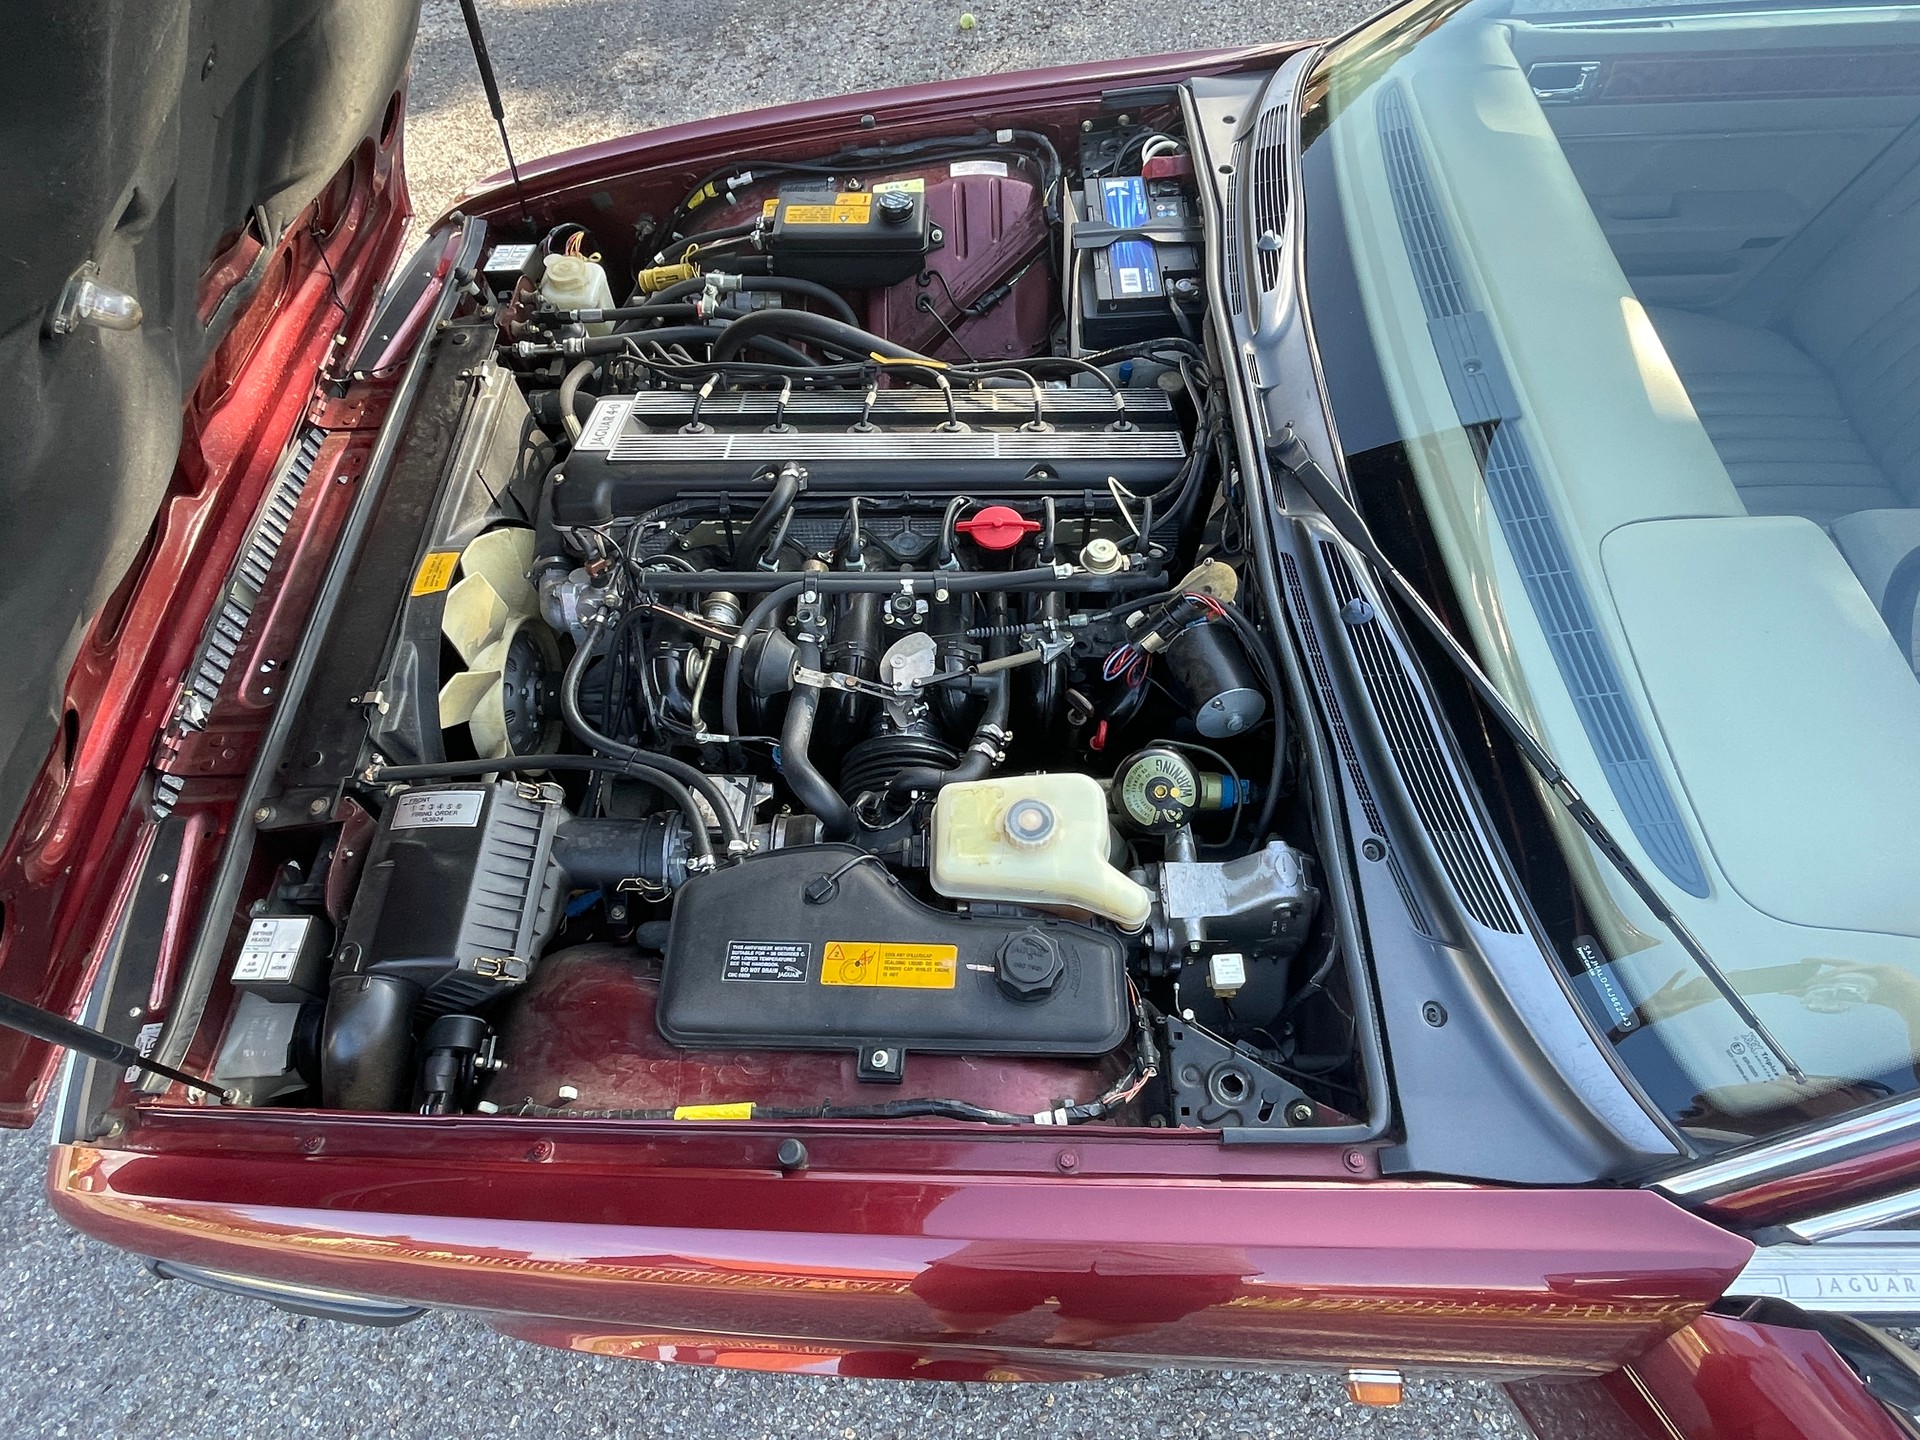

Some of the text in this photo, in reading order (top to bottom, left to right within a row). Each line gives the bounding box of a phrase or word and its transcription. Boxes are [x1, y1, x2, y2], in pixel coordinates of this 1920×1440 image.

[590, 416, 615, 445] JAGUAR
[1156, 759, 1193, 798] WARNING
[409, 797, 431, 805] FRONT
[1816, 1276, 1917, 1296] JAGUAR
